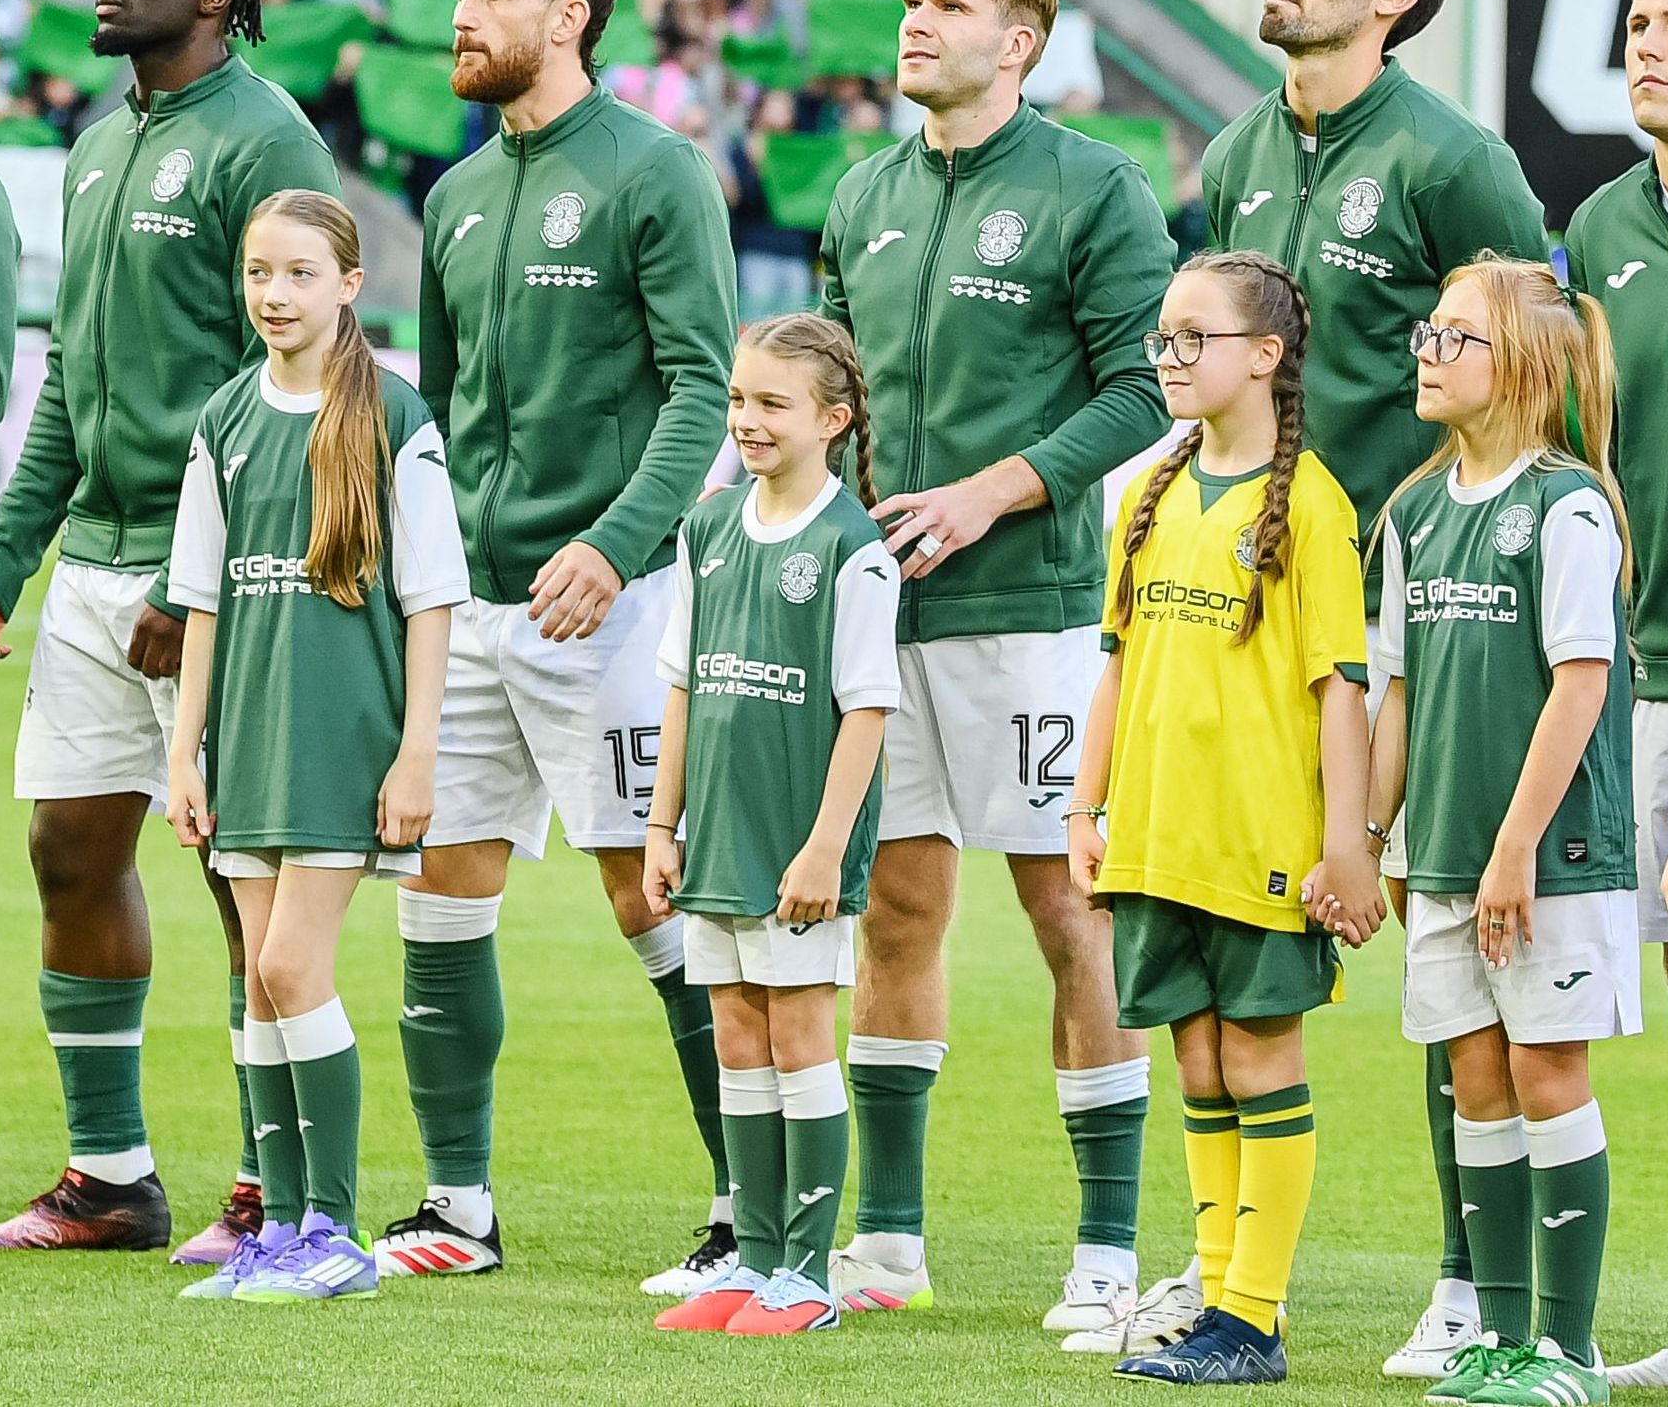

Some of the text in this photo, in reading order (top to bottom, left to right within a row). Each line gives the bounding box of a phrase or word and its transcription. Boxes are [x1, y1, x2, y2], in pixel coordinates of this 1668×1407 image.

[1406, 580, 1425, 606] G
[1178, 609, 1218, 627] Sons
[1488, 607, 1518, 623] Ltd
[709, 652, 806, 688] Gibson
[735, 682, 780, 701] Sons
[779, 690, 805, 705] Ltd
[1011, 713, 1075, 787] 12
